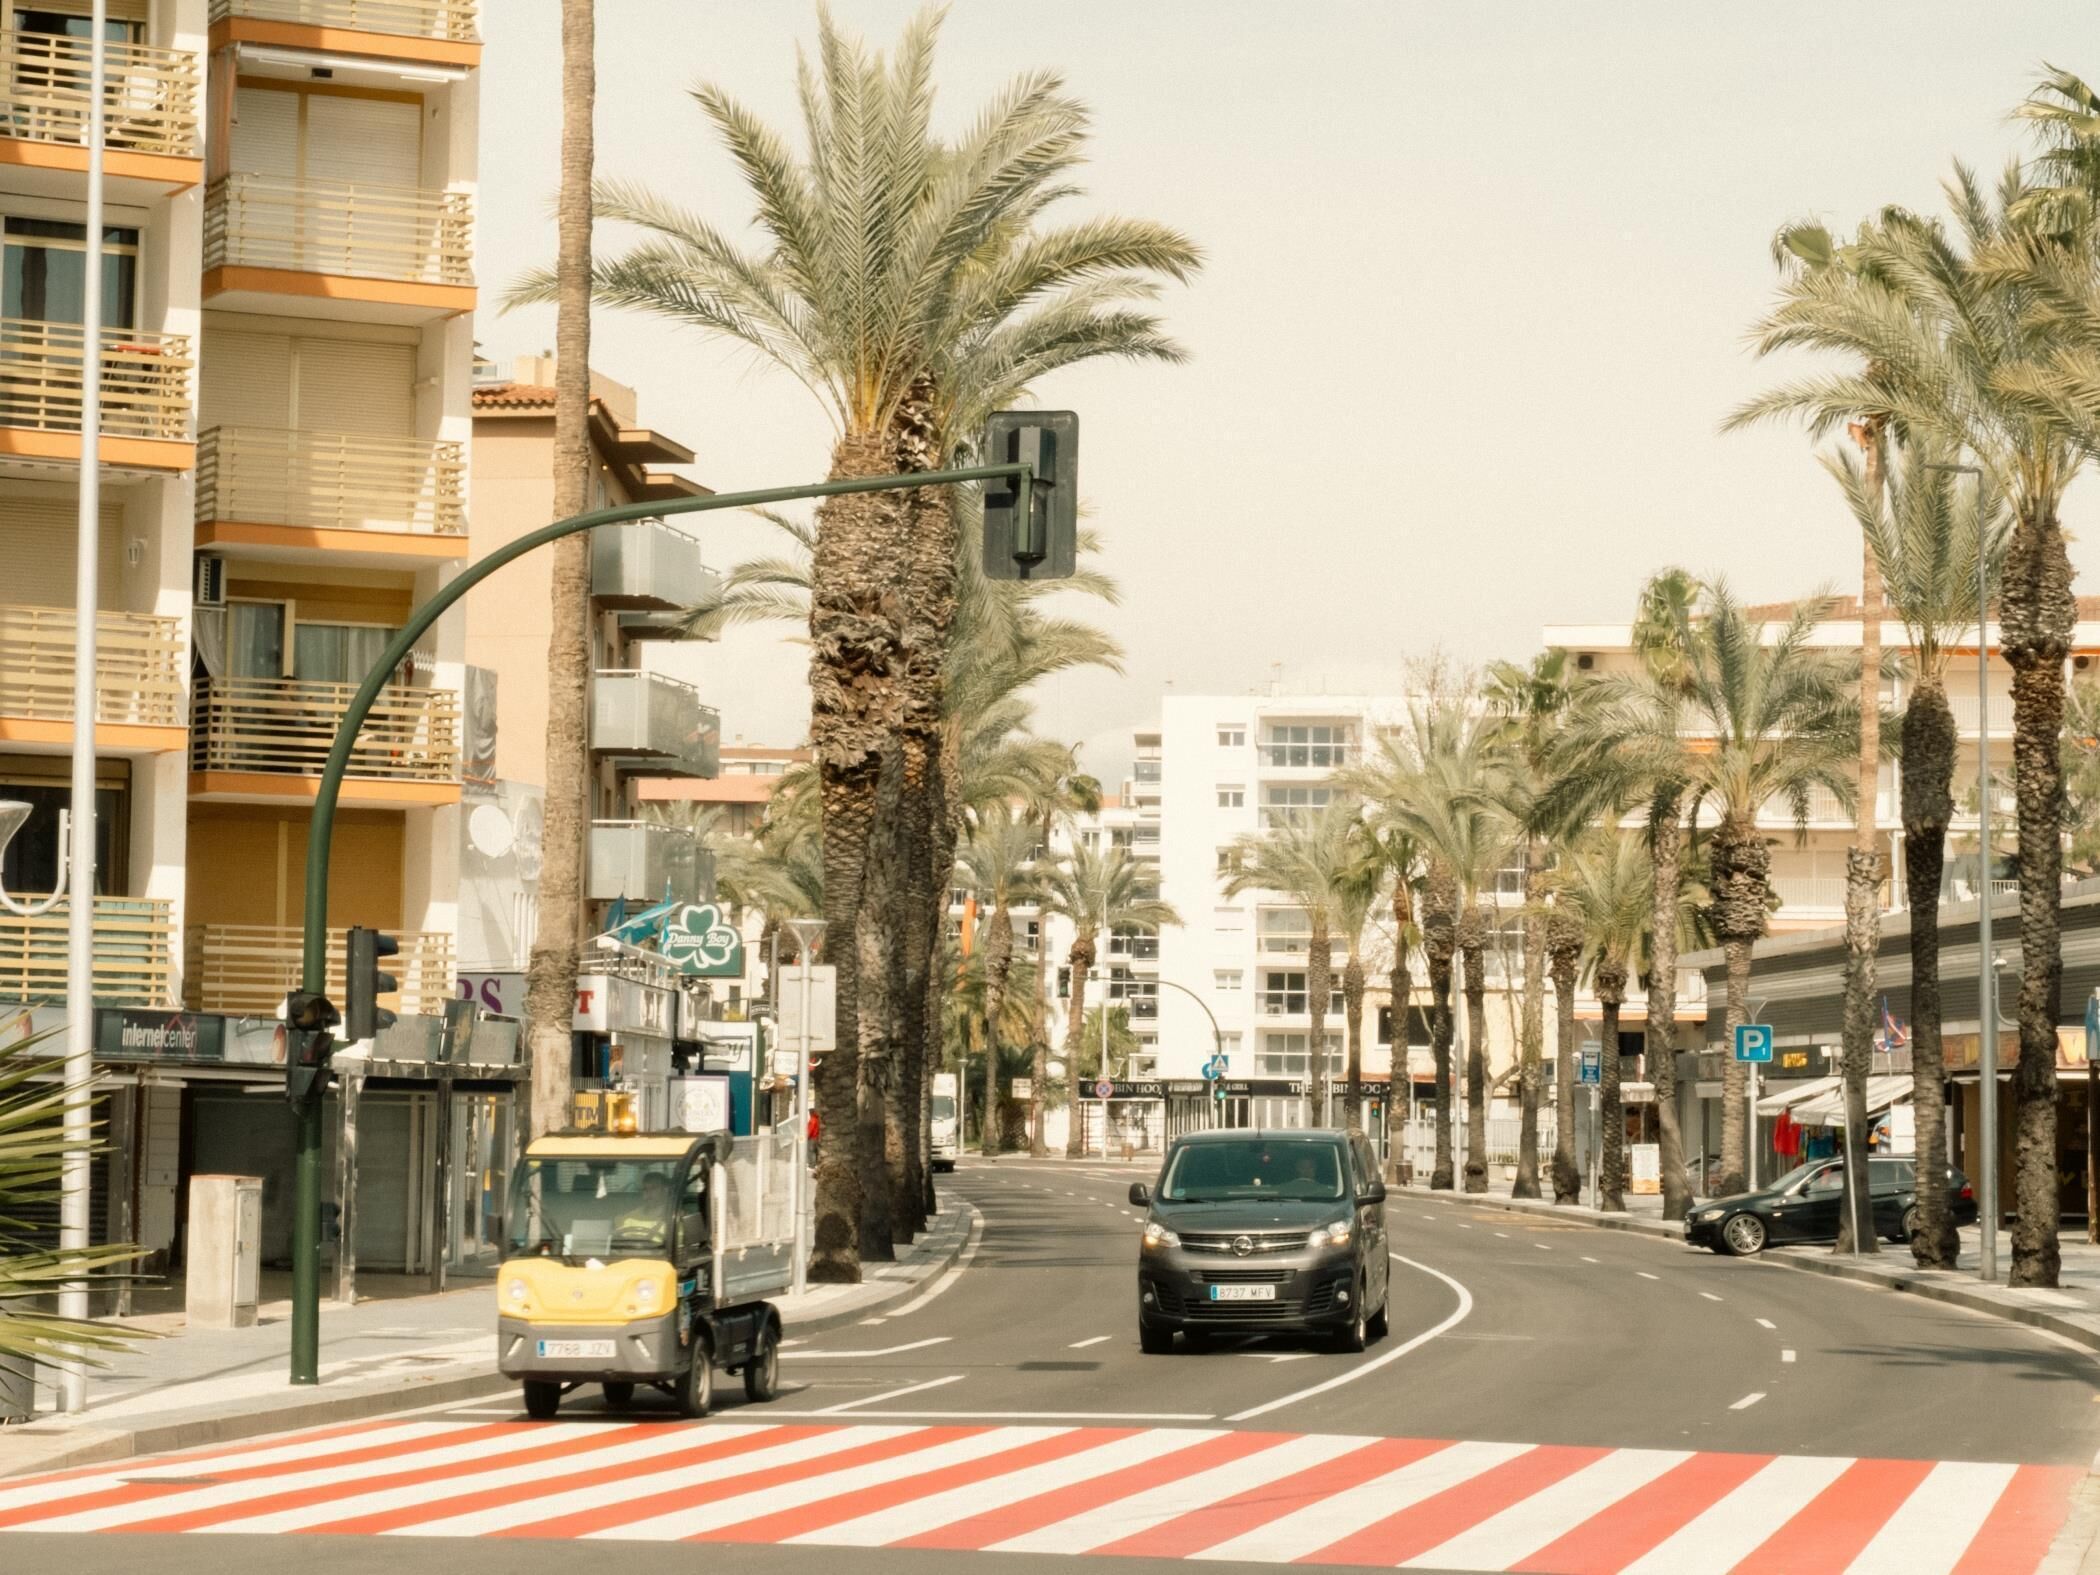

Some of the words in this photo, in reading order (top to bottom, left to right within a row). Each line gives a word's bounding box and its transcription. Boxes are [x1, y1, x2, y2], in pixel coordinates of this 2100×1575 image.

[670, 932, 704, 948] Danny
[705, 932, 730, 948] Boy
[1743, 1029, 1764, 1057] P
